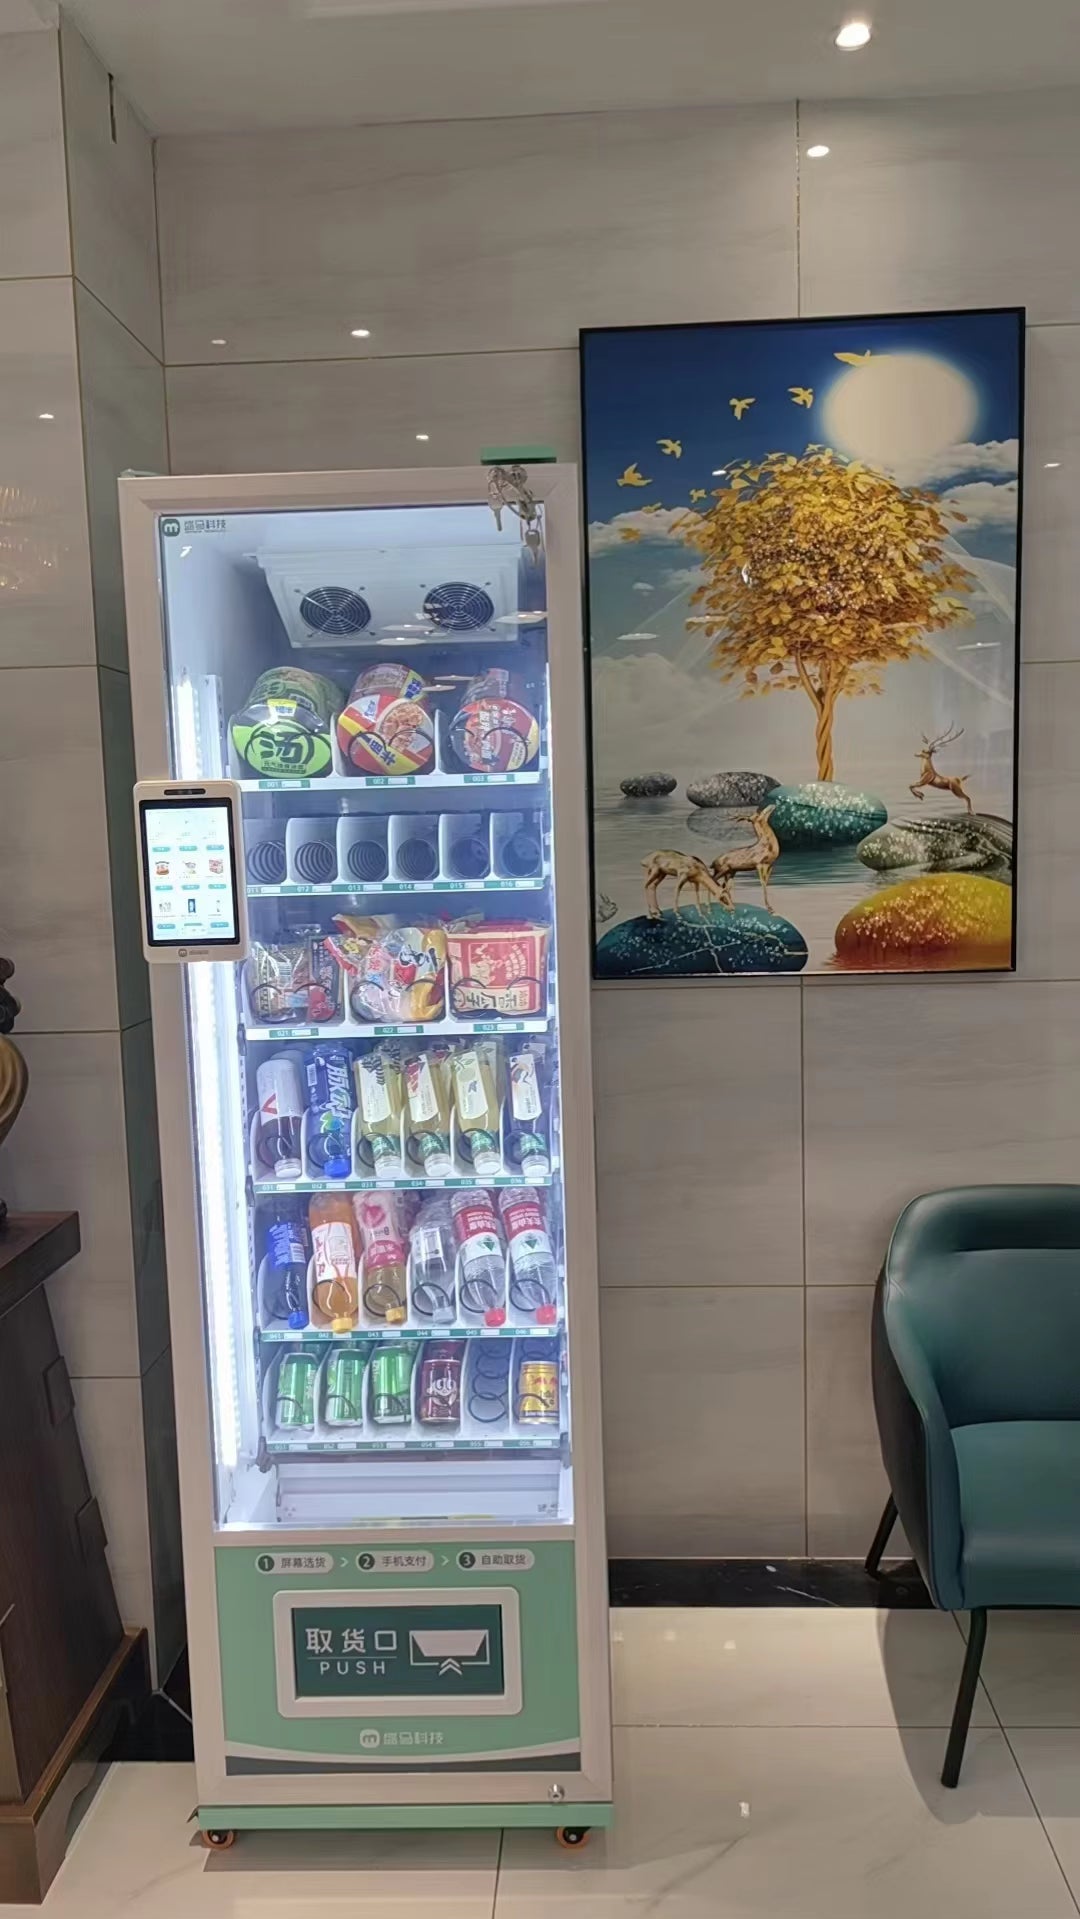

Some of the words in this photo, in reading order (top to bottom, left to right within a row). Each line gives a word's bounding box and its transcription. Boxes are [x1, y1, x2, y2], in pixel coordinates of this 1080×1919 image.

[280, 1557, 327, 1569] 屏幕选货
[381, 1555, 427, 1568] 手机支付
[480, 1553, 526, 1566] 自助取货
[305, 1628, 398, 1654] 取货口
[319, 1661, 386, 1675] PUSH
